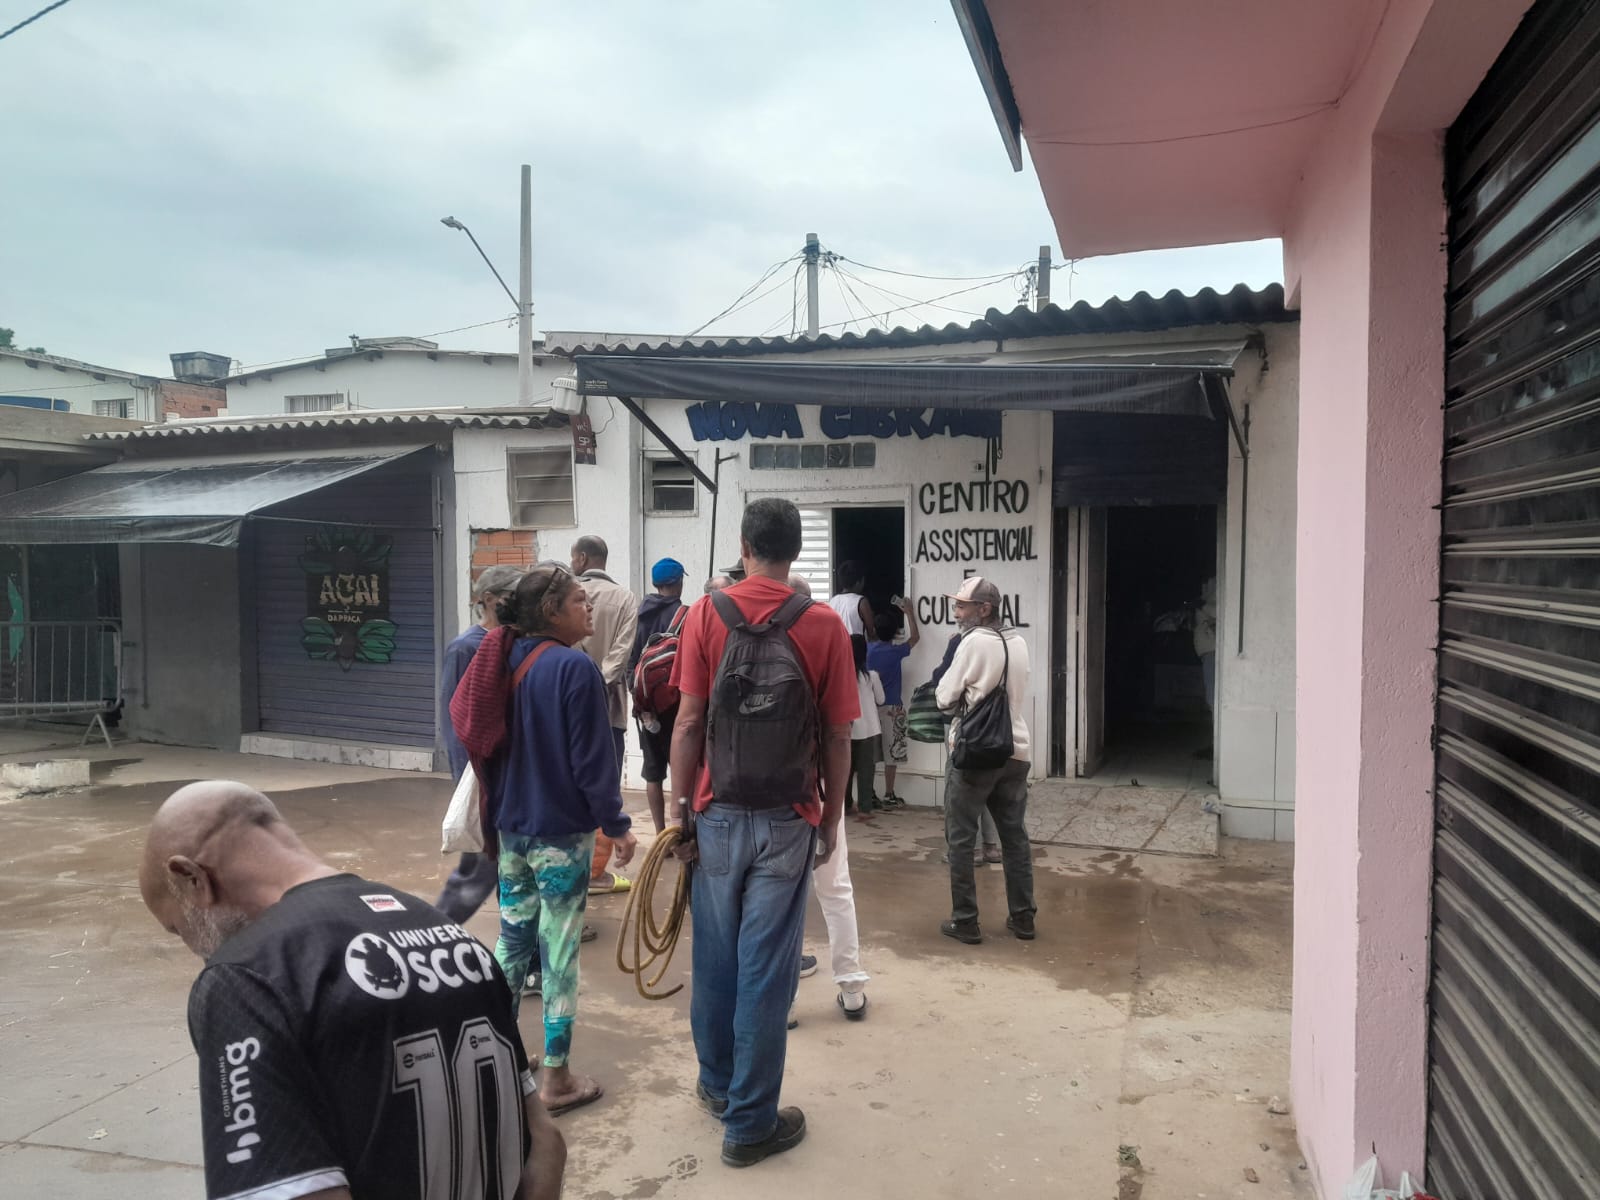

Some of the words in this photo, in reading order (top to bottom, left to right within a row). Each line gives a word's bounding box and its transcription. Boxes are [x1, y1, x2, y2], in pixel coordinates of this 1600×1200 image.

[685, 401, 804, 441] NOVA
[918, 479, 1029, 515] CENTRO
[915, 525, 1038, 563] ASSISTENCIAL
[917, 594, 1030, 628] CULAL
[388, 923, 476, 949] UNIVERS
[407, 941, 494, 994] SCCP
[218, 1055, 231, 1118] CORINTHIANS
[225, 1036, 261, 1133] bmg
[392, 1016, 525, 1200] 10
